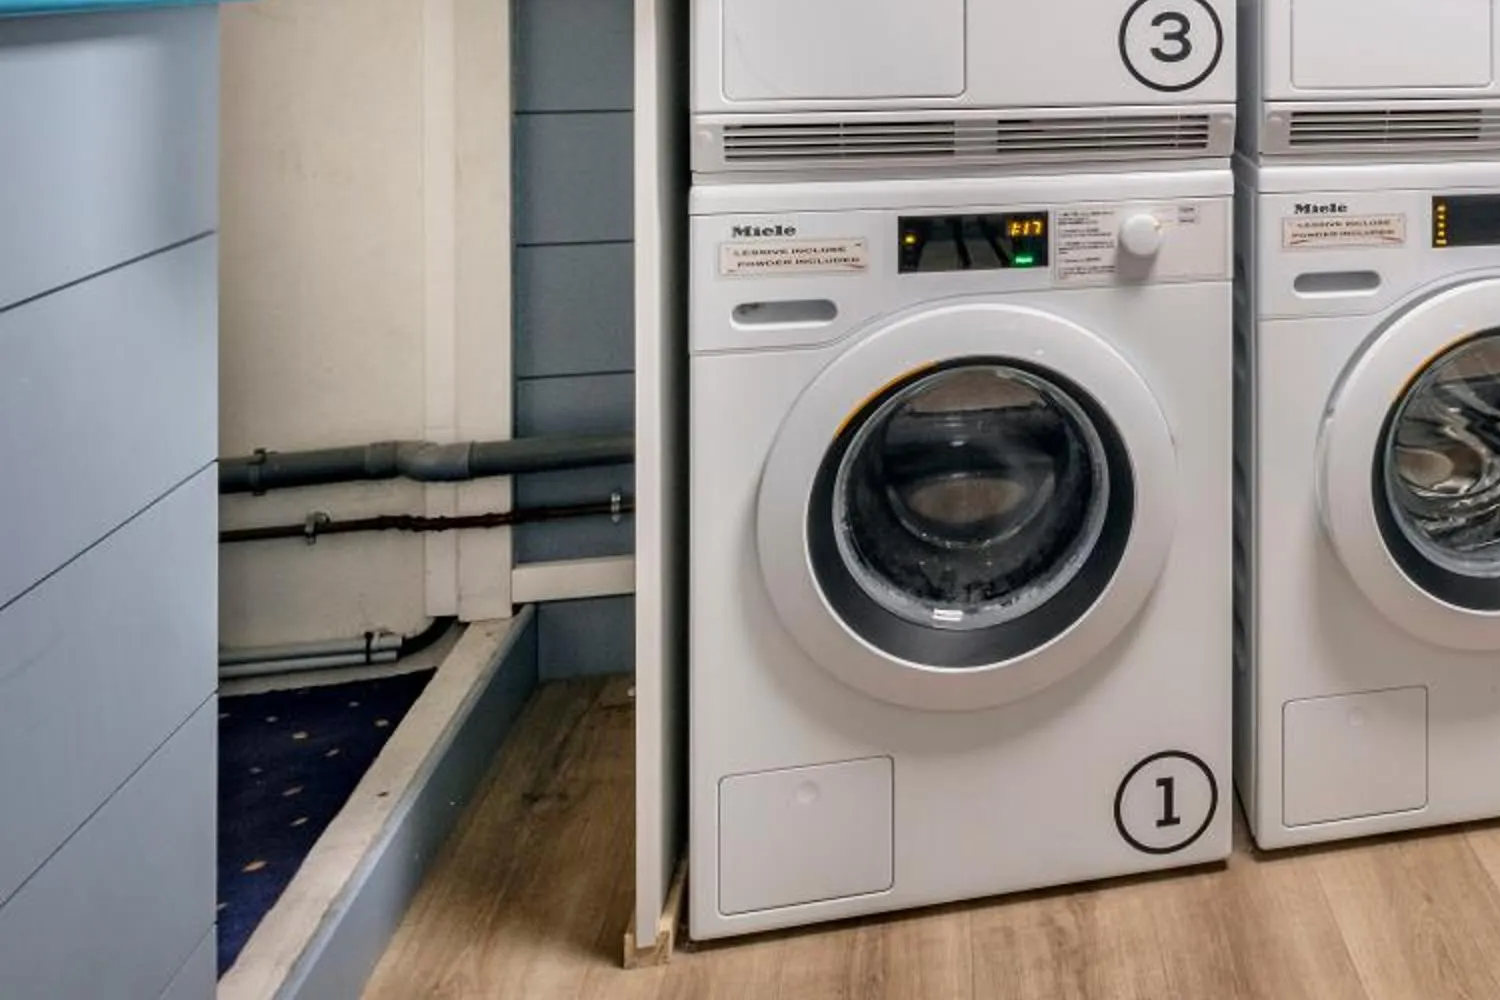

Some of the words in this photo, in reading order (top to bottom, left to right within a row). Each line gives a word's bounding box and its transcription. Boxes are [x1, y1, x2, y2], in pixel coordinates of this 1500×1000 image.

[1150, 11, 1192, 63] 3
[1294, 203, 1348, 214] Miele
[732, 225, 797, 238] Miele
[1155, 776, 1181, 828] 1
